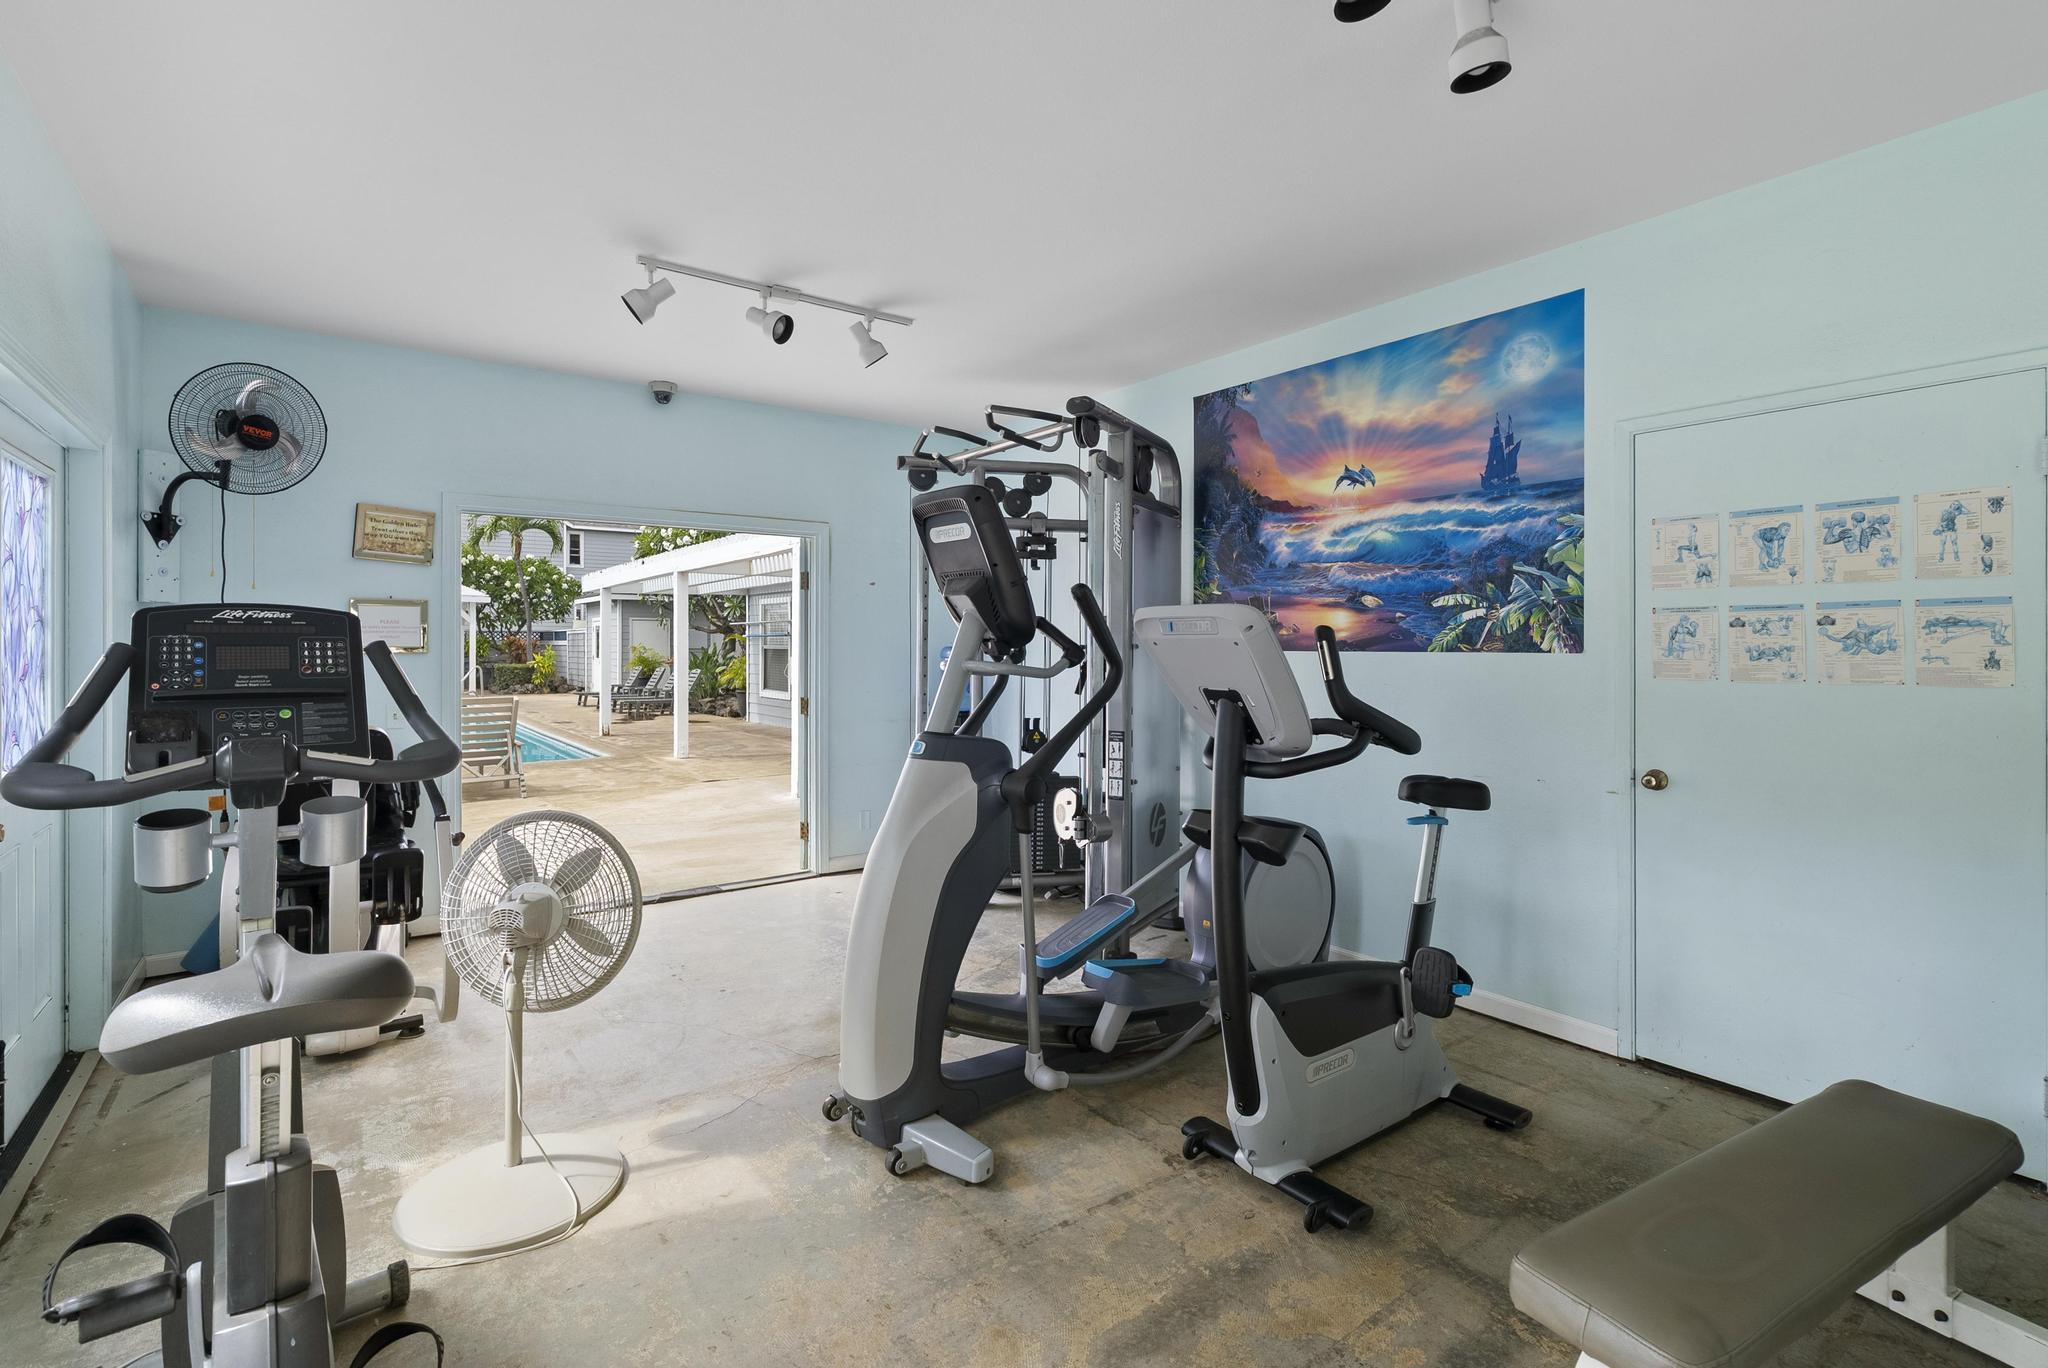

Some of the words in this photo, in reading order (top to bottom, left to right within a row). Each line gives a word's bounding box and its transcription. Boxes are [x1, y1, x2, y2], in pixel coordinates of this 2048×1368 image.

[240, 425, 273, 438] VEVOR
[382, 519, 405, 527] Golden
[242, 610, 294, 619] Fitness
